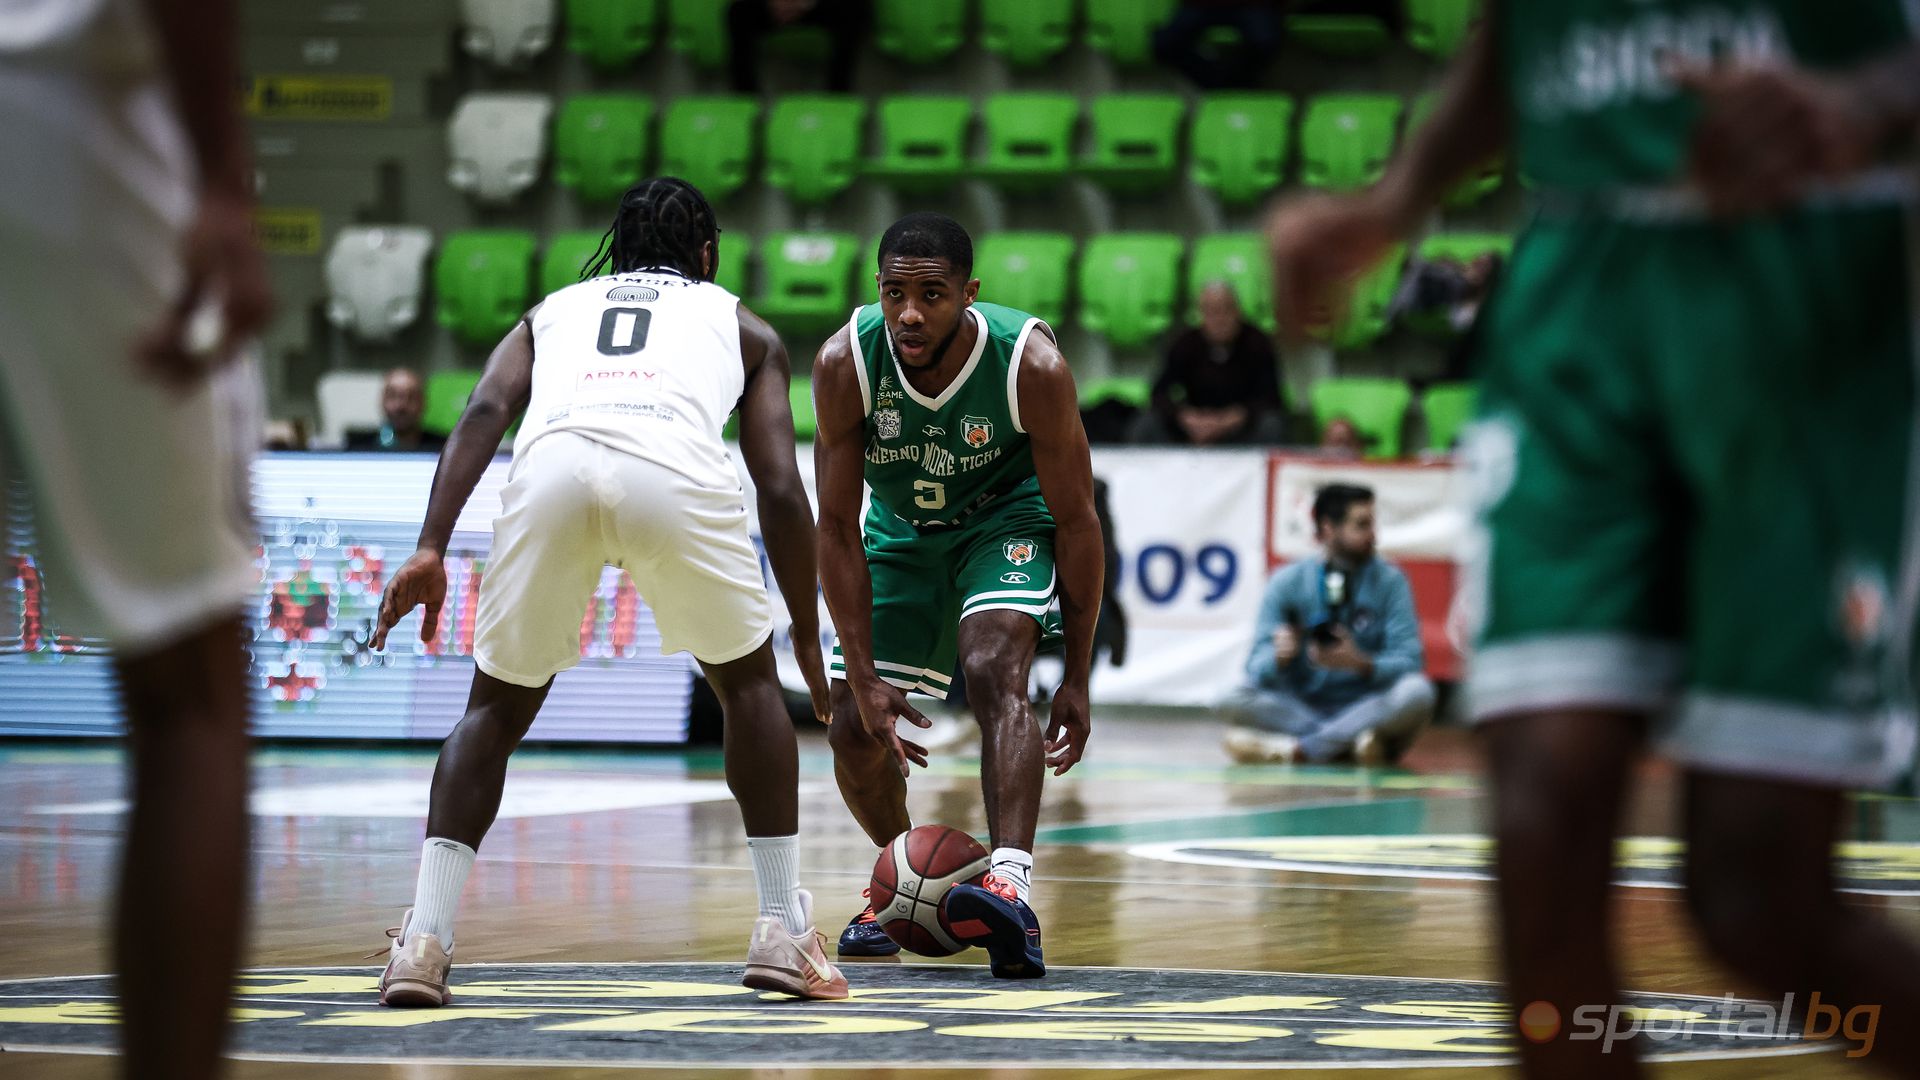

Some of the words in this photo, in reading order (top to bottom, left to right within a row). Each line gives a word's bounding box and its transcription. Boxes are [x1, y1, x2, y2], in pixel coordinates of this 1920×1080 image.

[594, 276, 699, 288] AMSEY
[596, 307, 652, 356] 0
[921, 442, 955, 476] MORE
